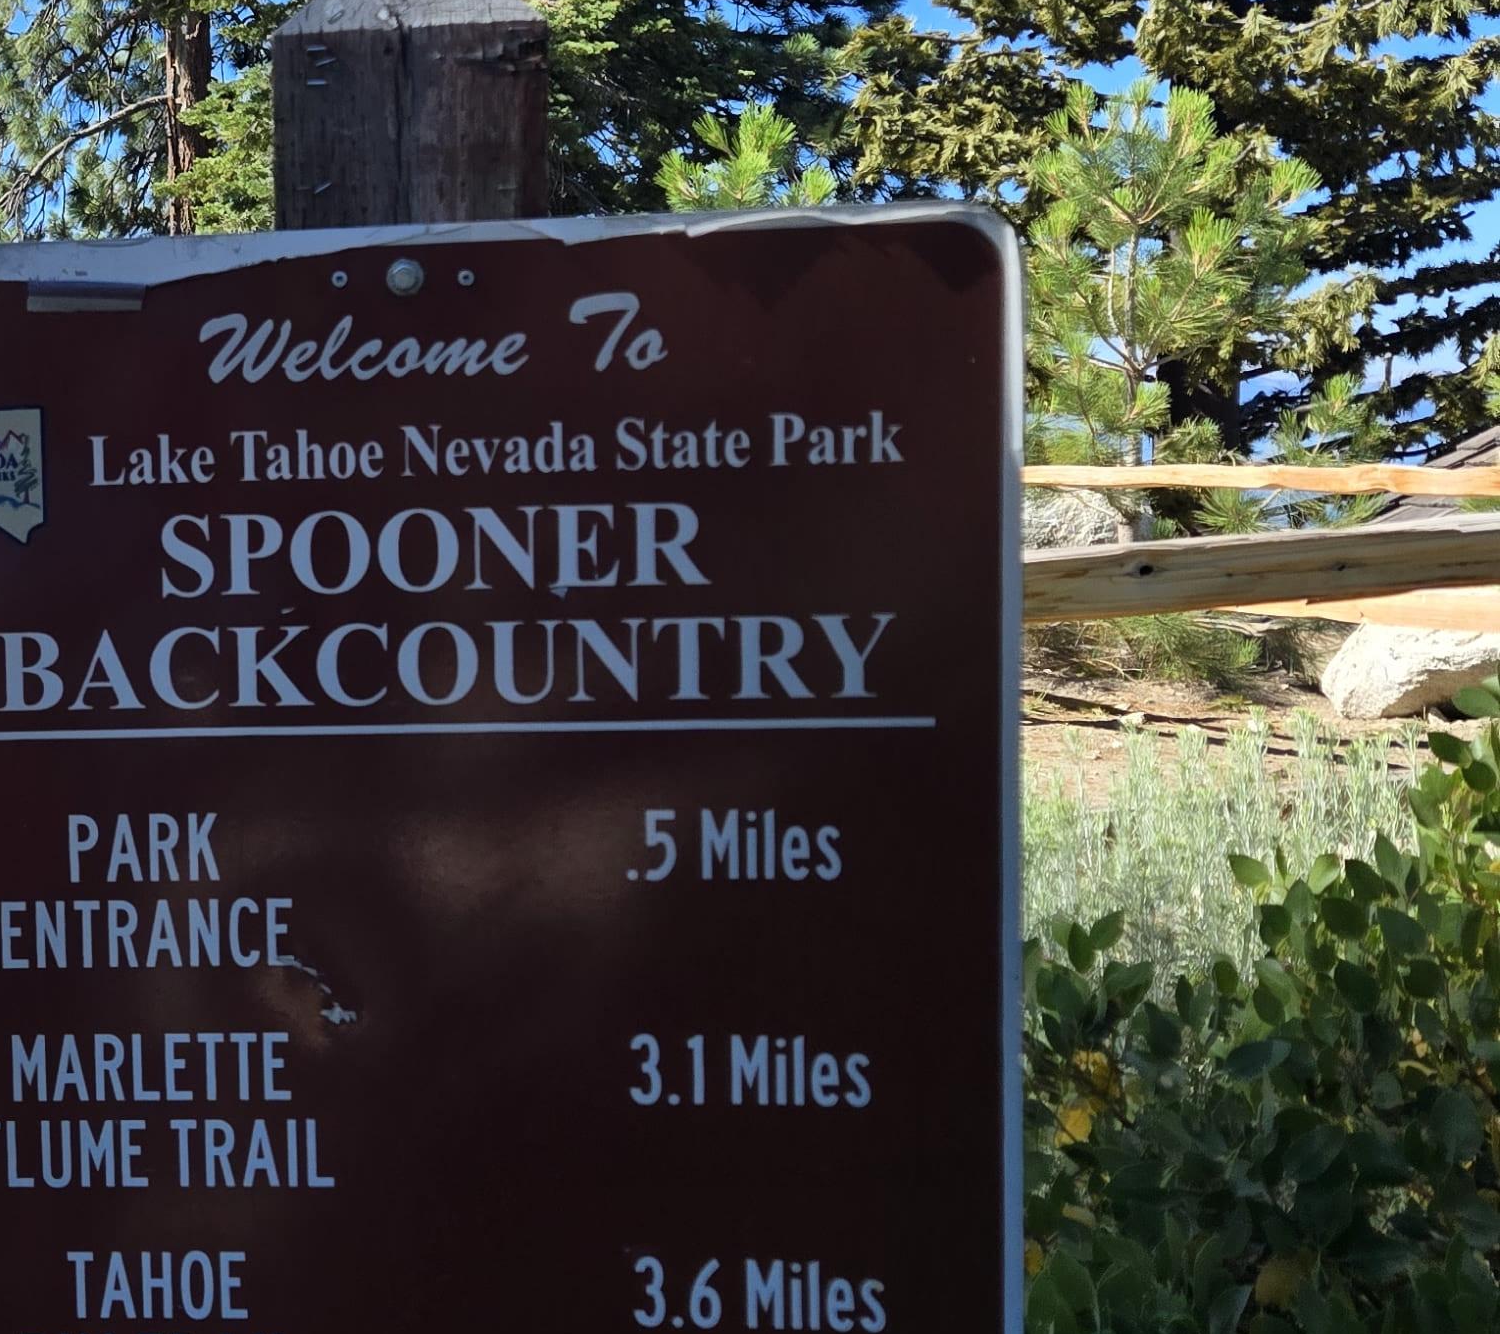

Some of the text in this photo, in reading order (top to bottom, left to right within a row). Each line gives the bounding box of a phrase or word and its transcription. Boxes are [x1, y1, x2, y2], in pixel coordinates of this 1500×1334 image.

[200, 293, 667, 383] Welcome To
[90, 411, 903, 485] Lake Tahoe Nevada State Park
[162, 503, 710, 597] SPOONER
[69, 813, 220, 882] PARK
[627, 809, 841, 880] .5 Miles
[1, 898, 295, 968] ENTRANCE
[12, 1032, 291, 1101] MARLETTE
[630, 1034, 870, 1107] 3.1 Miles
[170, 1119, 334, 1187] TRAIL
[67, 1251, 248, 1319] TAHOE
[634, 1256, 885, 1332] 3.6 Miles
